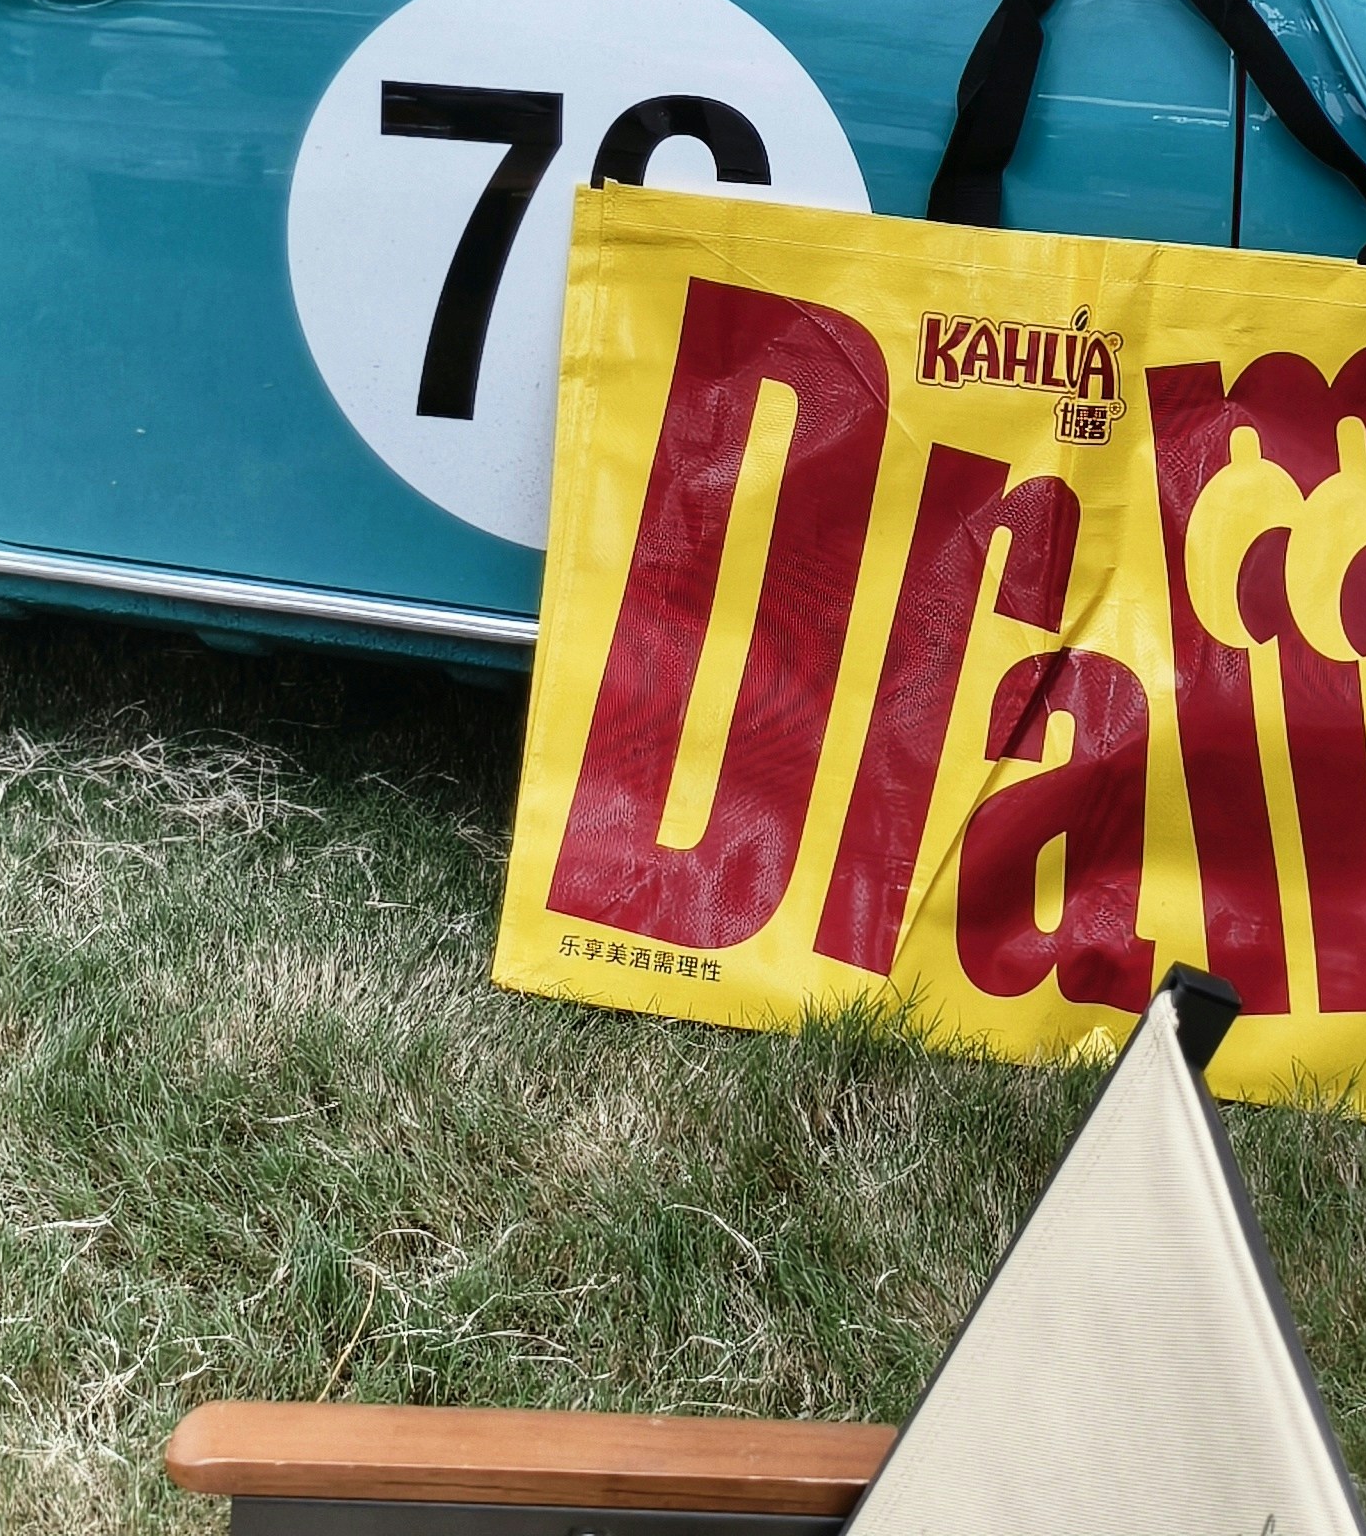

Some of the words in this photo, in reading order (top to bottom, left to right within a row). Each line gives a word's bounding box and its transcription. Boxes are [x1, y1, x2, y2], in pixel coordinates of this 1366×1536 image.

[1059, 395, 1109, 441] 甘露
[558, 933, 724, 983] 乐享美酒需理性
